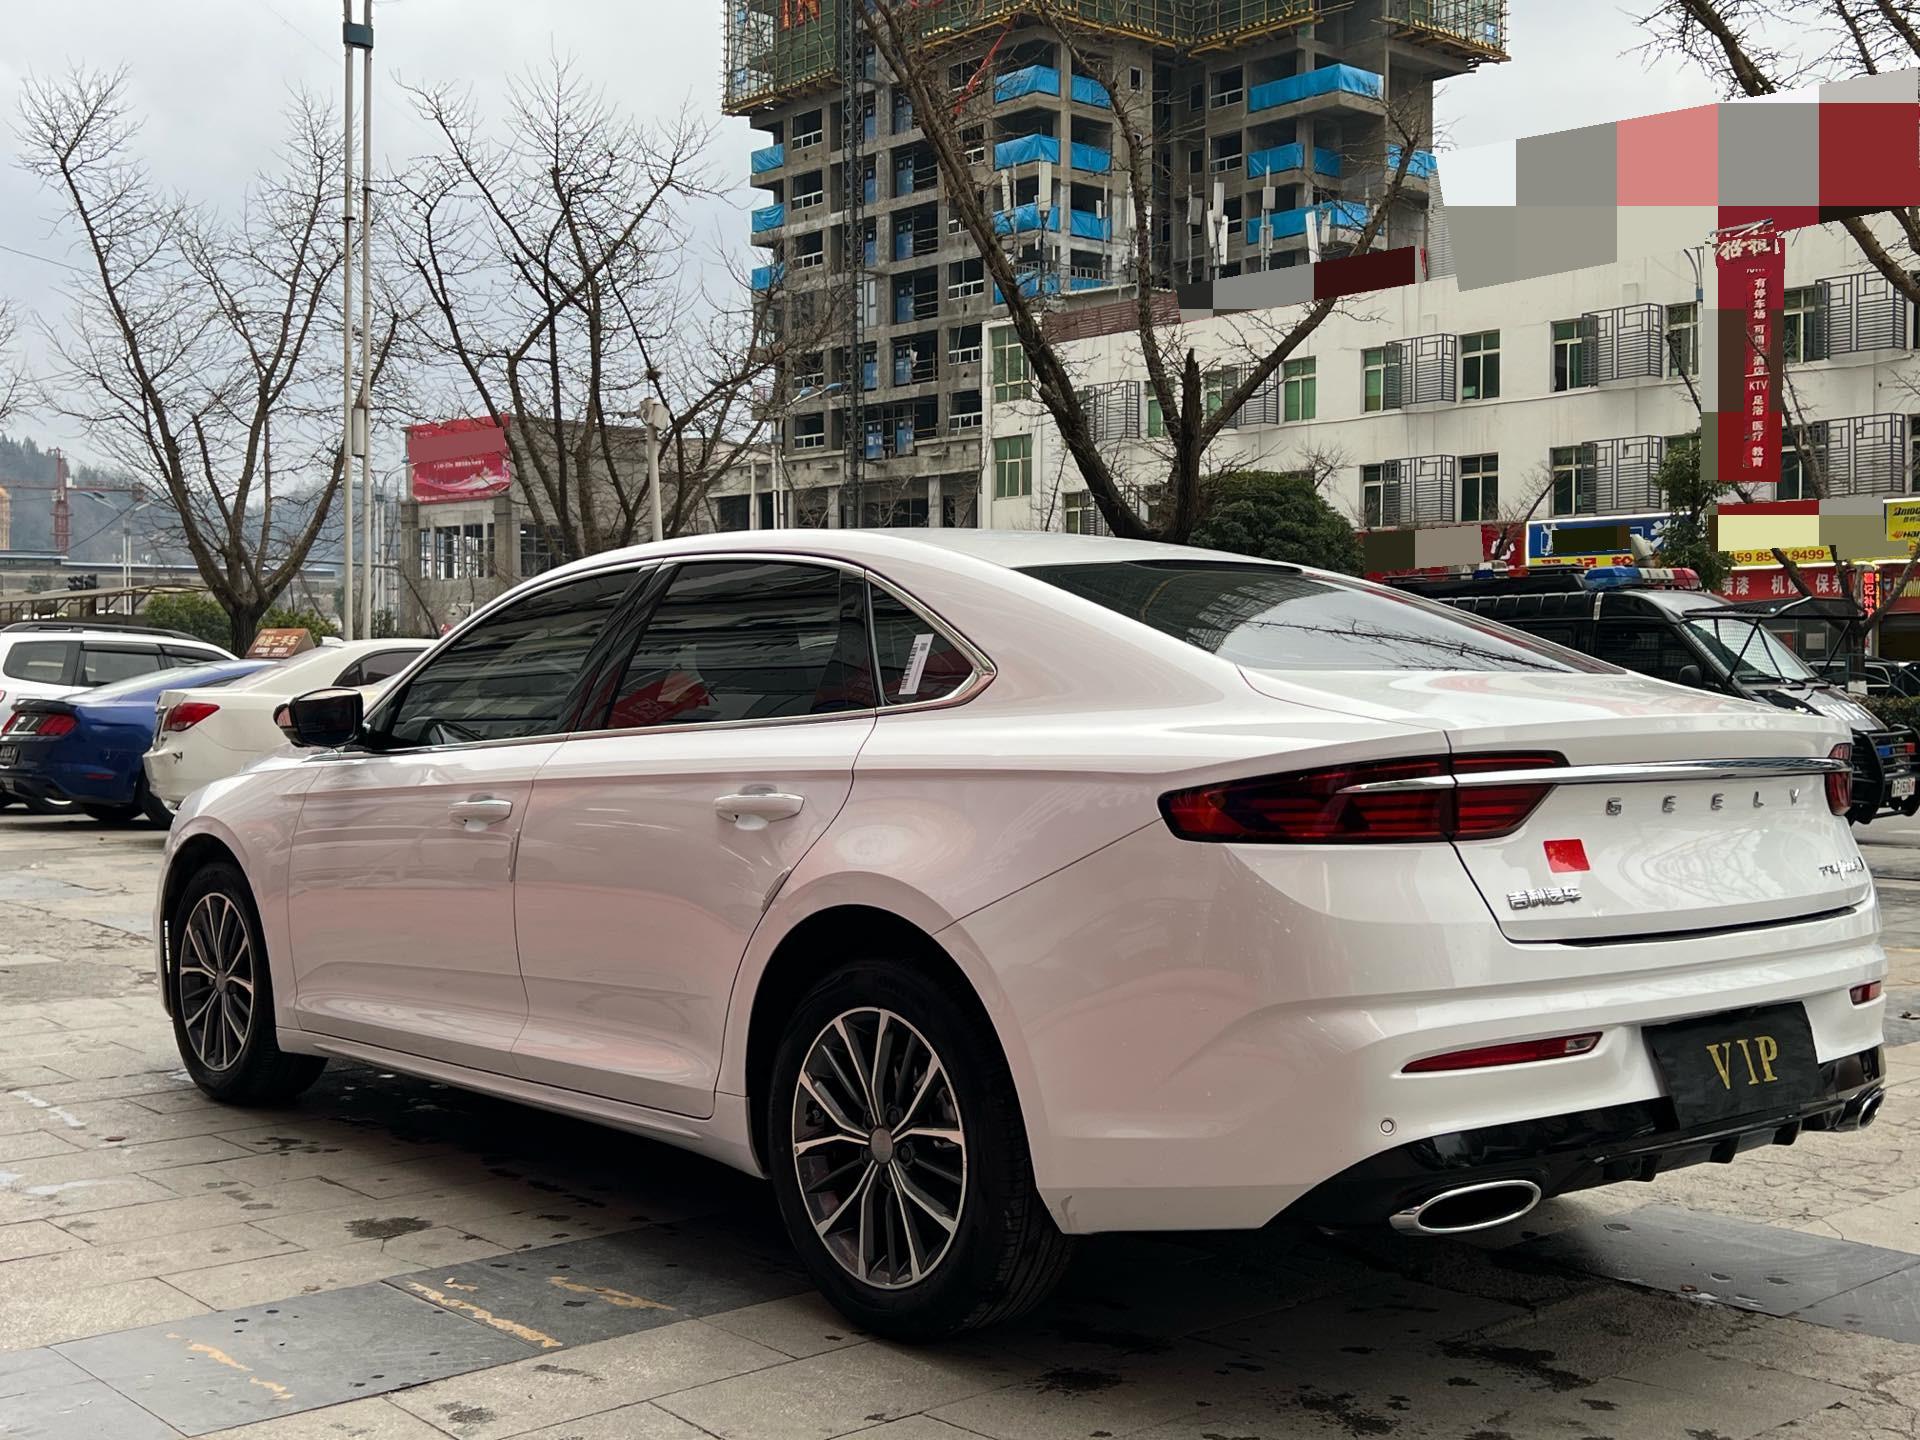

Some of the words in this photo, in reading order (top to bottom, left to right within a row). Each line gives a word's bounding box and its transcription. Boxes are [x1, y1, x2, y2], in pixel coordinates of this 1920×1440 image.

[1753, 278, 1766, 319] 有停车场
[1748, 380, 1768, 391] KTV
[1752, 395, 1764, 416] 足浴
[1752, 421, 1764, 442] 医疗
[1751, 446, 1764, 468] 教育
[1791, 549, 1825, 561] 9499
[1606, 788, 1800, 816] GEELY
[1506, 886, 1582, 910] 吉利汽车
[1706, 1035, 1778, 1090] VIP
